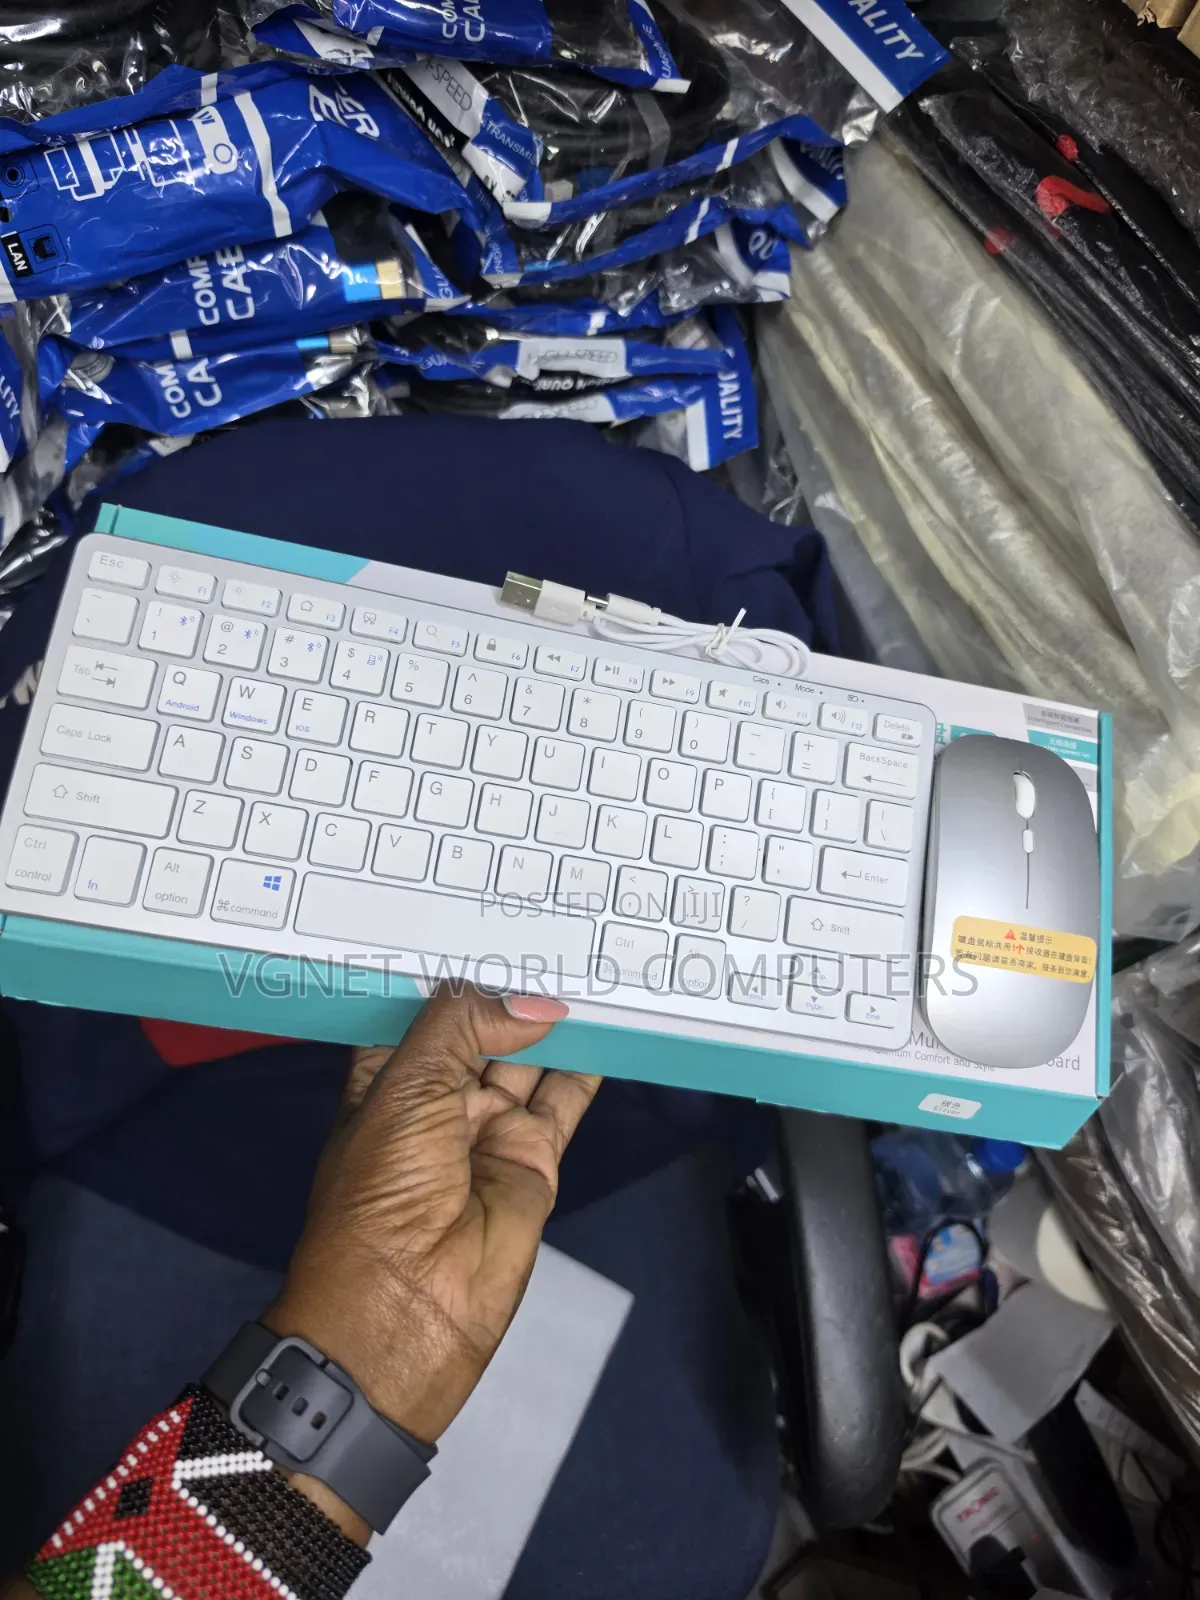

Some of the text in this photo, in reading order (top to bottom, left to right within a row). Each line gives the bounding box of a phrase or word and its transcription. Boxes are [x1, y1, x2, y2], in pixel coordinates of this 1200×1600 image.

[7, 242, 28, 271] LAN
[100, 554, 125, 569] Esc
[197, 586, 207, 594] F1
[261, 600, 271, 609] F2
[326, 614, 336, 622] F3
[220, 621, 234, 633] @
[388, 627, 399, 635] F4
[152, 630, 157, 641] 1
[284, 634, 295, 644] #
[217, 644, 228, 655] 2
[451, 640, 460, 648] F5
[347, 647, 355, 658] $
[511, 653, 521, 661] F6
[279, 657, 289, 668] 3
[408, 659, 420, 671] %
[570, 665, 580, 673] F7
[172, 671, 187, 686] Q
[342, 669, 351, 680] 4
[628, 677, 638, 685] F8
[752, 675, 770, 685] Caps
[239, 684, 256, 700] W
[404, 682, 414, 693] 5
[525, 684, 533, 695] &
[685, 688, 695, 696] F9
[795, 684, 815, 694] Mode
[165, 699, 200, 712] Android
[302, 697, 314, 711] E
[464, 694, 473, 705] 6
[738, 699, 751, 708] F10
[229, 710, 268, 725] Windows
[364, 710, 376, 724] R
[522, 705, 531, 717] 7
[426, 722, 437, 735] T
[580, 717, 588, 728] 8
[851, 722, 863, 730] F12
[884, 719, 910, 732] Delete
[56, 725, 112, 743] Caps Lock
[487, 733, 498, 747] Y
[634, 728, 643, 739] 9
[173, 734, 185, 748] A
[803, 740, 814, 751] +
[241, 746, 253, 760] S
[544, 744, 556, 758] U
[305, 758, 317, 772] D
[859, 752, 908, 769] BackSpace
[369, 770, 380, 783] F
[657, 767, 670, 780] O
[430, 781, 443, 795] G
[714, 778, 724, 791] P
[76, 791, 101, 804] Shift
[489, 793, 502, 807] H
[193, 800, 207, 814] Z
[549, 803, 558, 817] J
[258, 811, 272, 825] X
[606, 814, 619, 829] K
[325, 823, 338, 837] C
[663, 825, 673, 839] L
[24, 837, 47, 850] Ctrl
[390, 834, 402, 848] V
[452, 845, 463, 859] B
[164, 861, 180, 874] Alt
[513, 856, 525, 870] N
[15, 869, 52, 882] control
[570, 866, 584, 881] M
[864, 872, 889, 885] Enter
[87, 880, 98, 891] fn
[155, 891, 188, 905] option
[743, 894, 751, 906] ?
[230, 904, 279, 919] command
[615, 936, 635, 949] Ctrl
[866, 1012, 880, 1021] End
[914, 1050, 951, 1065] Comfort
[953, 1057, 970, 1068] and
